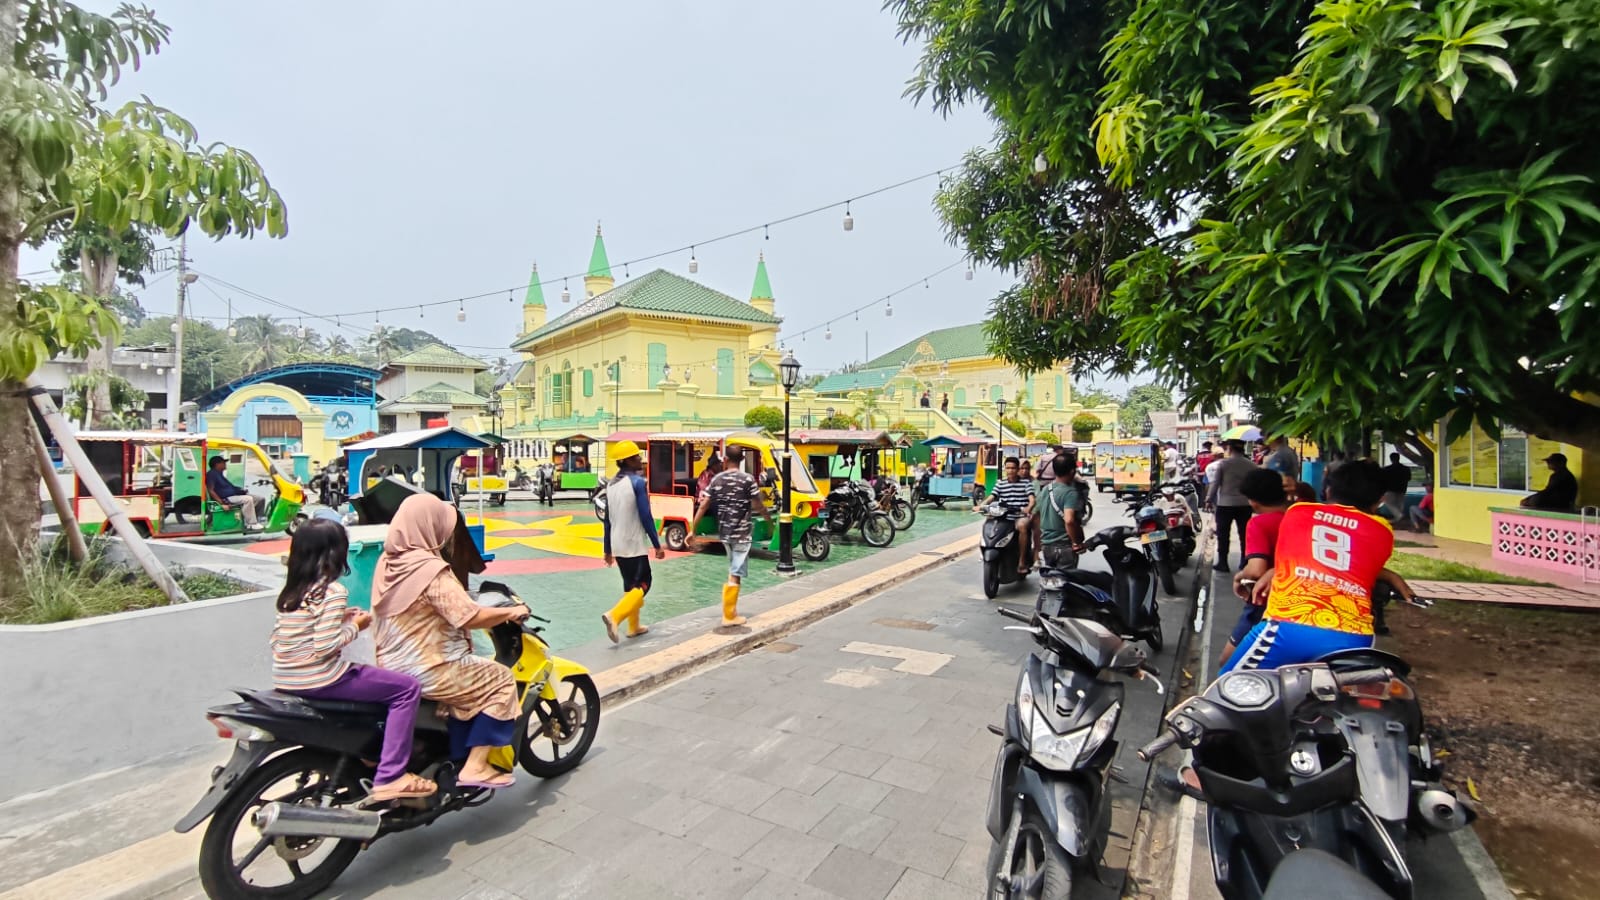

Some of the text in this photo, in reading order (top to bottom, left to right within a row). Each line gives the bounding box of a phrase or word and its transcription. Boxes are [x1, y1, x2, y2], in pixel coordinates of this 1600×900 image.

[1313, 510, 1358, 530] SABIO
[1312, 524, 1351, 571] 8
[1295, 566, 1336, 584] ONE
